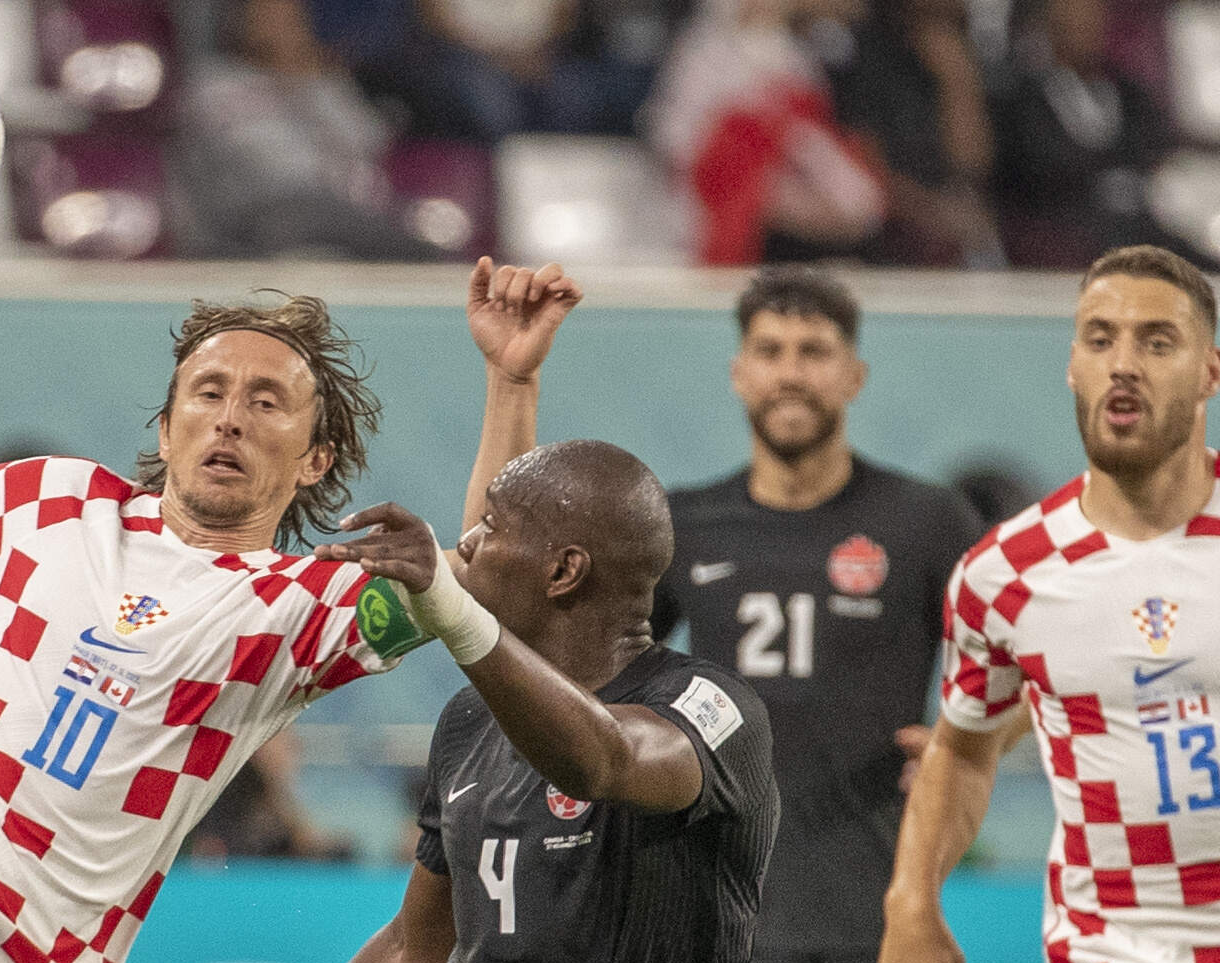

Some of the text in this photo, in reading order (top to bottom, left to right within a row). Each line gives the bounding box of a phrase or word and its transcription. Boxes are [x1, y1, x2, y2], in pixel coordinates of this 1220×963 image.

[737, 592, 815, 678] 21
[21, 685, 119, 791] 10
[1147, 724, 1220, 815] 13
[479, 839, 519, 934] 4
